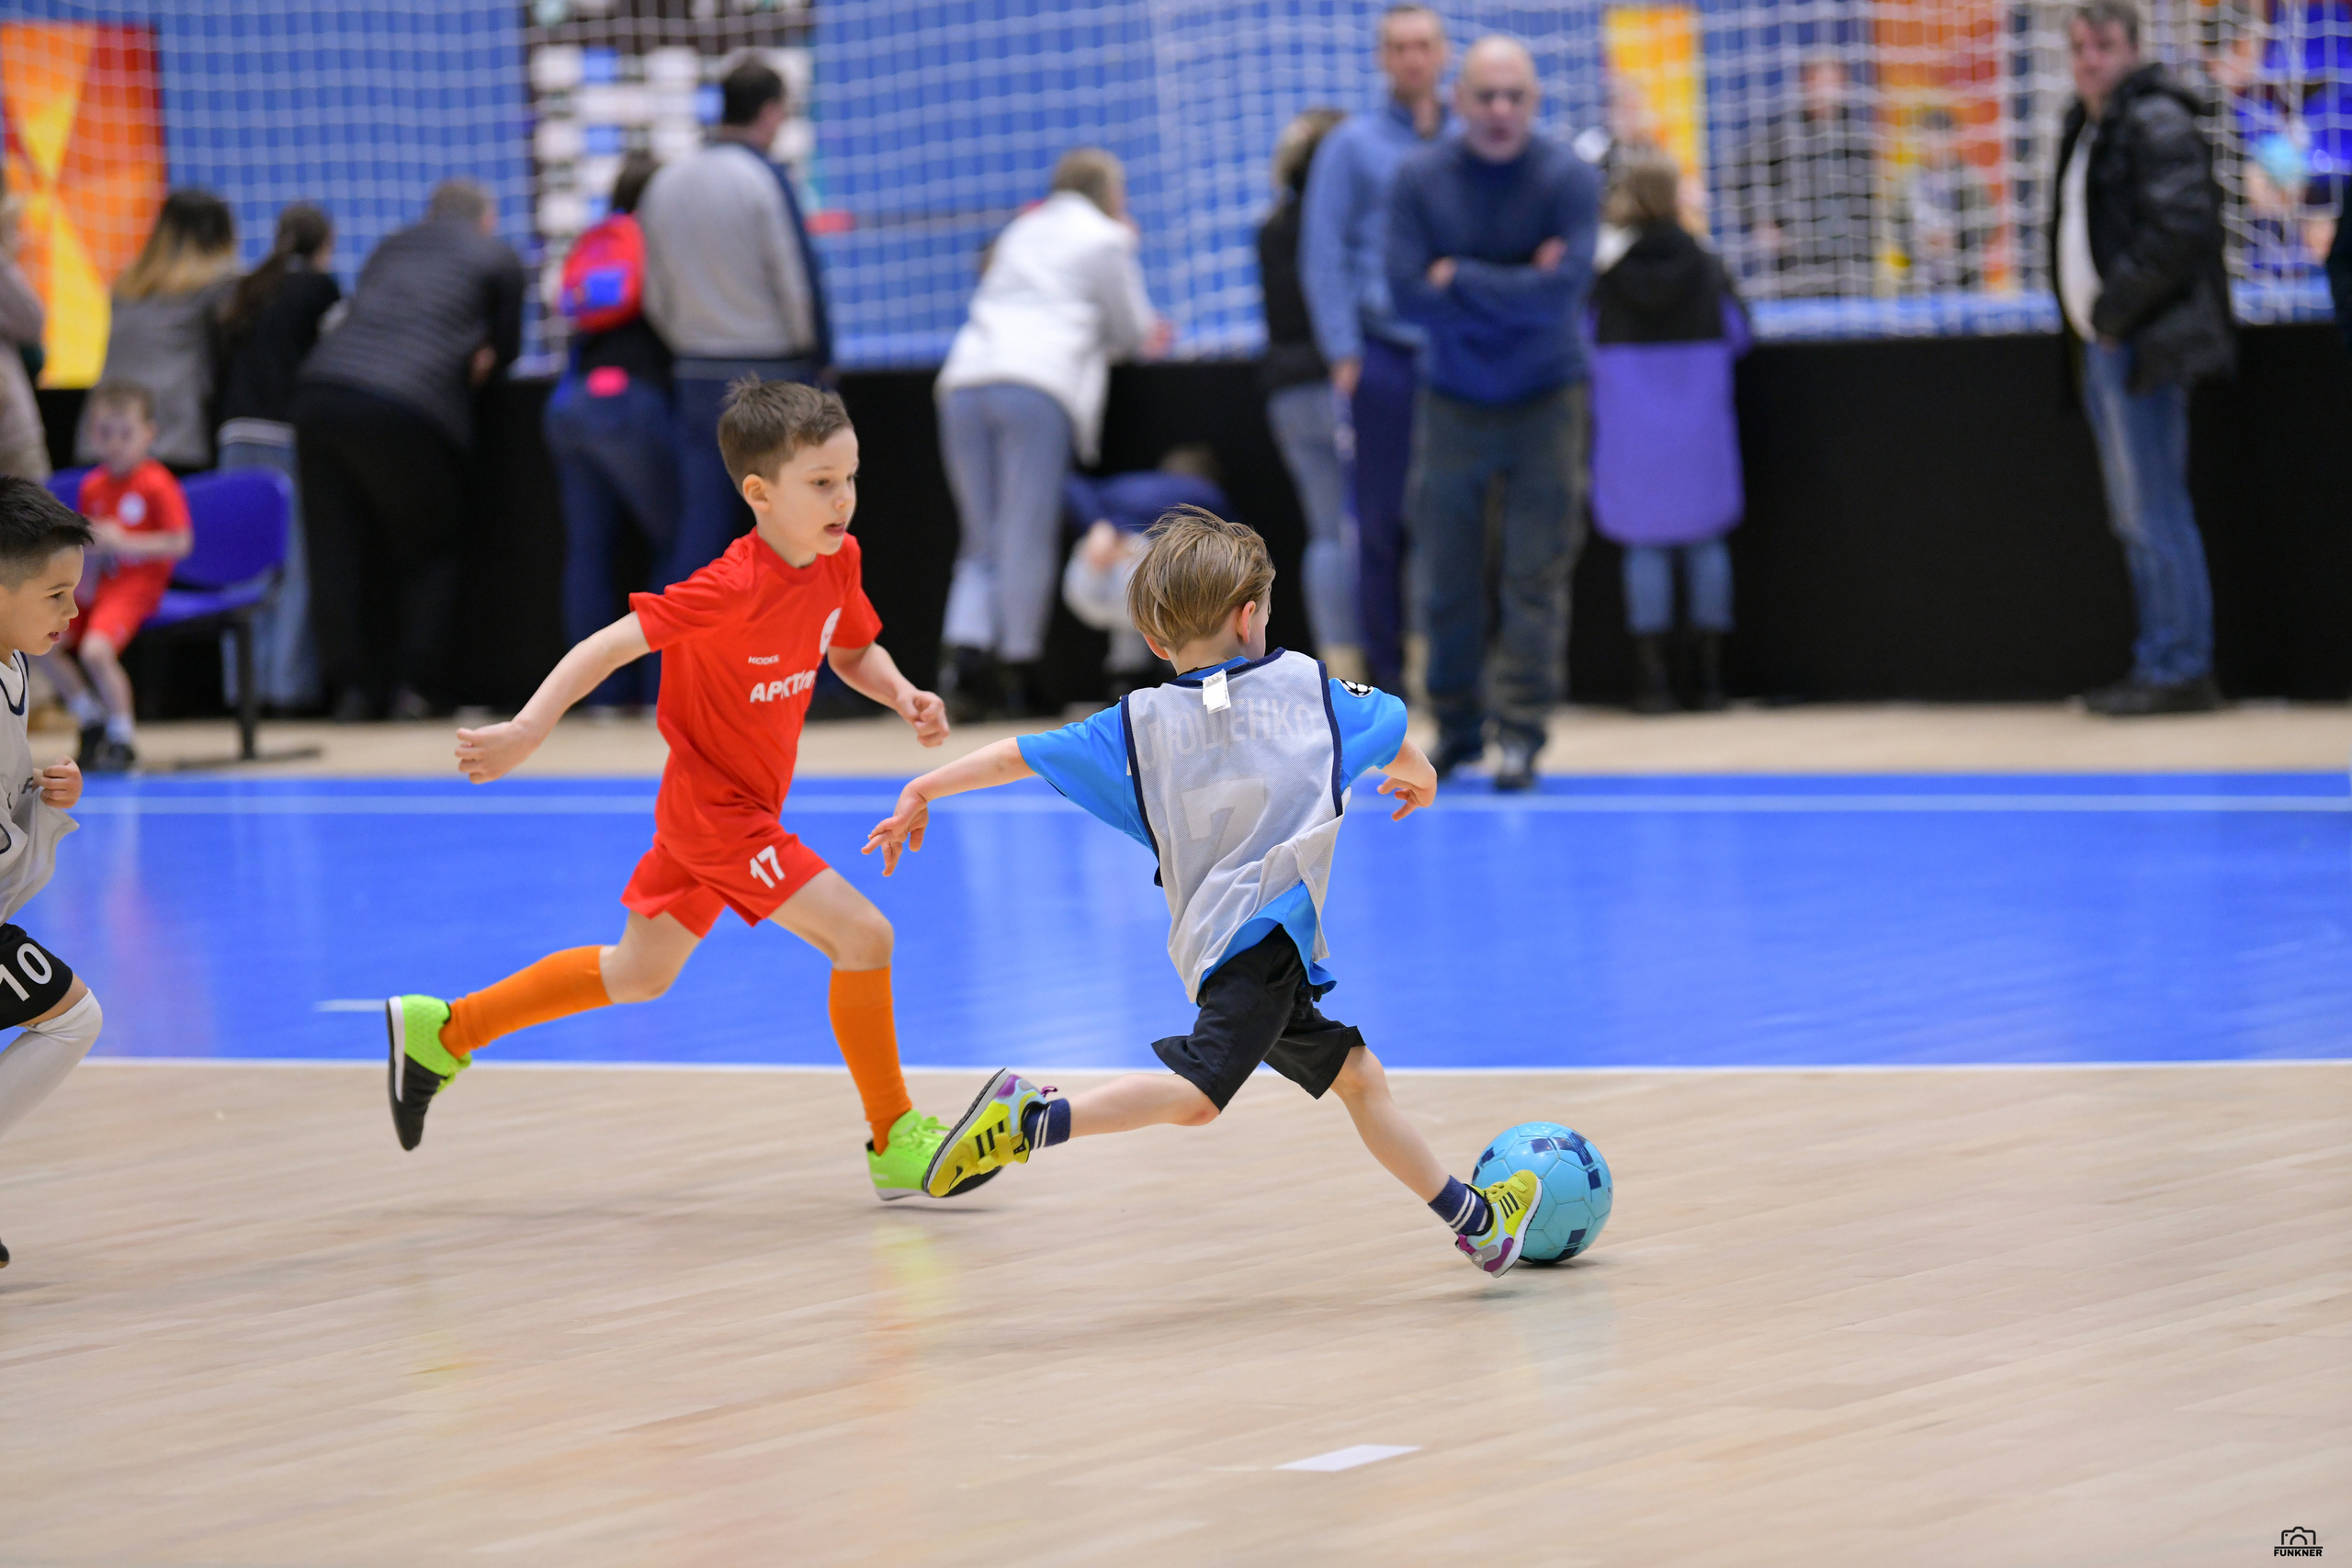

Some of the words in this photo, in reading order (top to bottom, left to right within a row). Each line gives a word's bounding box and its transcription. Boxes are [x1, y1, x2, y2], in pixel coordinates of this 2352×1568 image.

[1181, 778, 1267, 868] 7
[750, 845, 786, 888] 17
[0, 942, 52, 1001] 10
